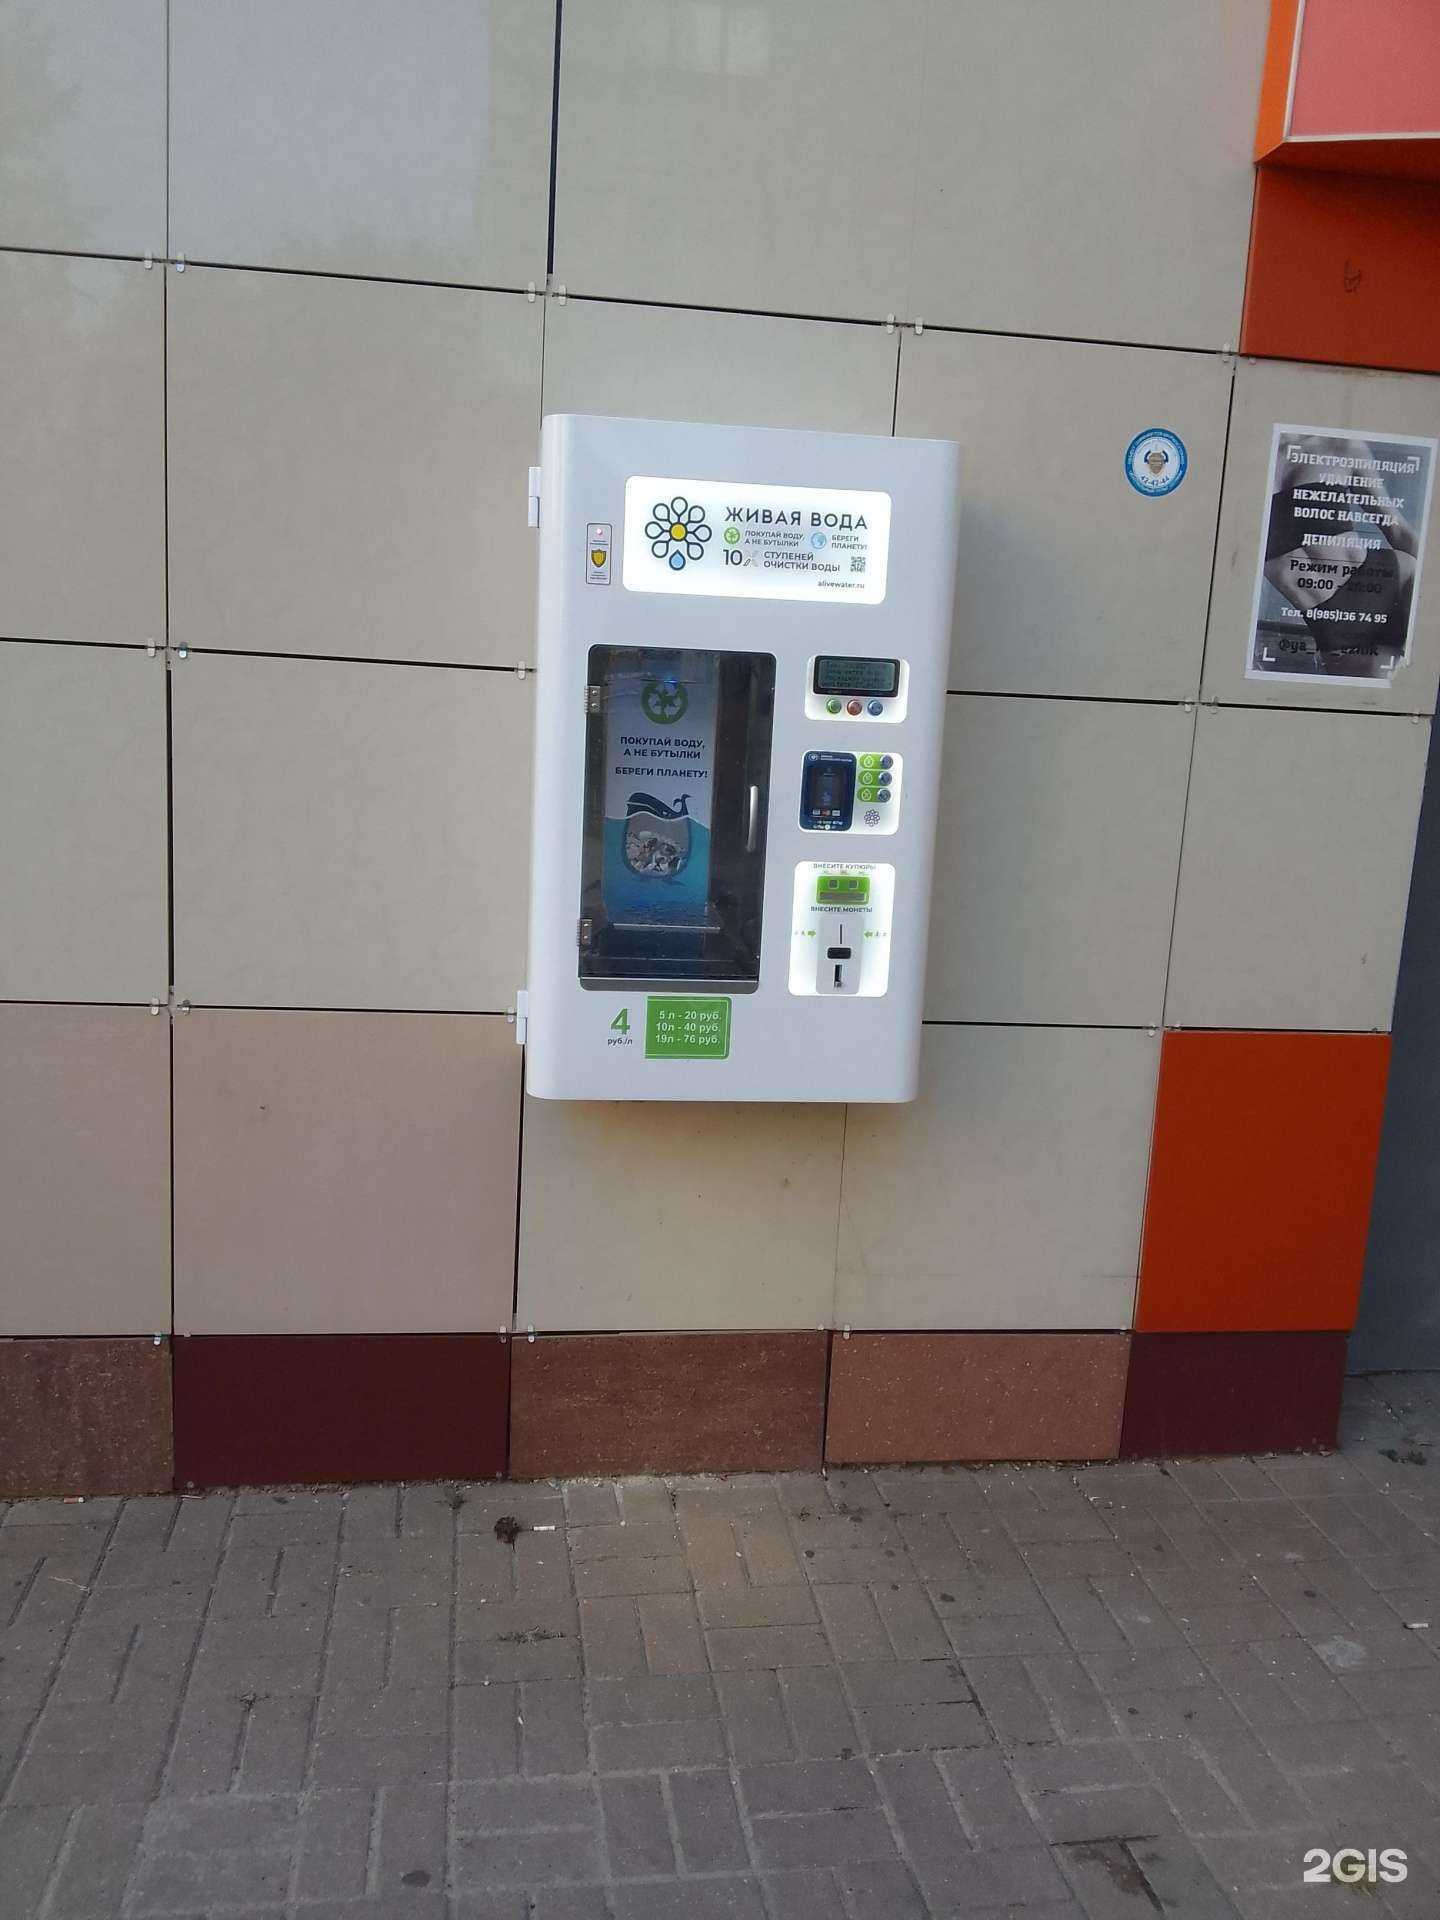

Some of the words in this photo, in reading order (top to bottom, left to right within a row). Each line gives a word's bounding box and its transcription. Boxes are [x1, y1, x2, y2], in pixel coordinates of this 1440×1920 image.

[1291, 452, 1415, 474] ЭЛЕКТРОЭПИЛЯЦИЯ
[1319, 473, 1385, 489] УДАЛЕНИЕ
[1293, 488, 1404, 509] НЕЖЕЛАТЕЛЬНЫХ
[725, 506, 801, 526] ЖИВАЯ
[810, 512, 868, 531] ВОДА
[1294, 506, 1336, 521] ВОЛОС
[1337, 510, 1400, 527] НАВСЕГДА
[744, 530, 782, 539] ПОКУПАЙ
[831, 534, 859, 543] БЕРЕГИ
[744, 538, 751, 546] А
[763, 540, 800, 548] БУТЫЛКИ
[1301, 533, 1382, 550] ДЕПИЛЯЦИЯ
[723, 549, 743, 566] 10
[763, 550, 814, 561] СТУПЕНЕЙ
[763, 560, 809, 570] ОЧИСТКИ
[811, 563, 841, 573] ВОДЫ
[1290, 559, 1338, 575] Режим
[817, 580, 865, 589] alivewater.ru
[1297, 577, 1334, 590] 09:00
[1281, 606, 1304, 618] Тел.
[1306, 608, 1356, 623] 8(985)136
[1359, 613, 1372, 623] 74
[1374, 614, 1388, 624] 95
[620, 736, 672, 747] ПОКУПАЙ
[674, 738, 706, 749] ВОДУ,
[624, 749, 632, 757] А
[633, 749, 648, 757] НЕ
[650, 750, 701, 760] БУТЫЛКИ
[615, 766, 655, 776] БЕРЕГИ
[656, 768, 708, 779] ПЛАНЕТУ!
[610, 1008, 631, 1035] 4
[659, 1010, 665, 1020] 5
[684, 1010, 697, 1020] 20
[656, 1022, 675, 1031] 10л
[683, 1022, 697, 1032] 40
[655, 1034, 674, 1043] 19л
[683, 1034, 696, 1043] 76
